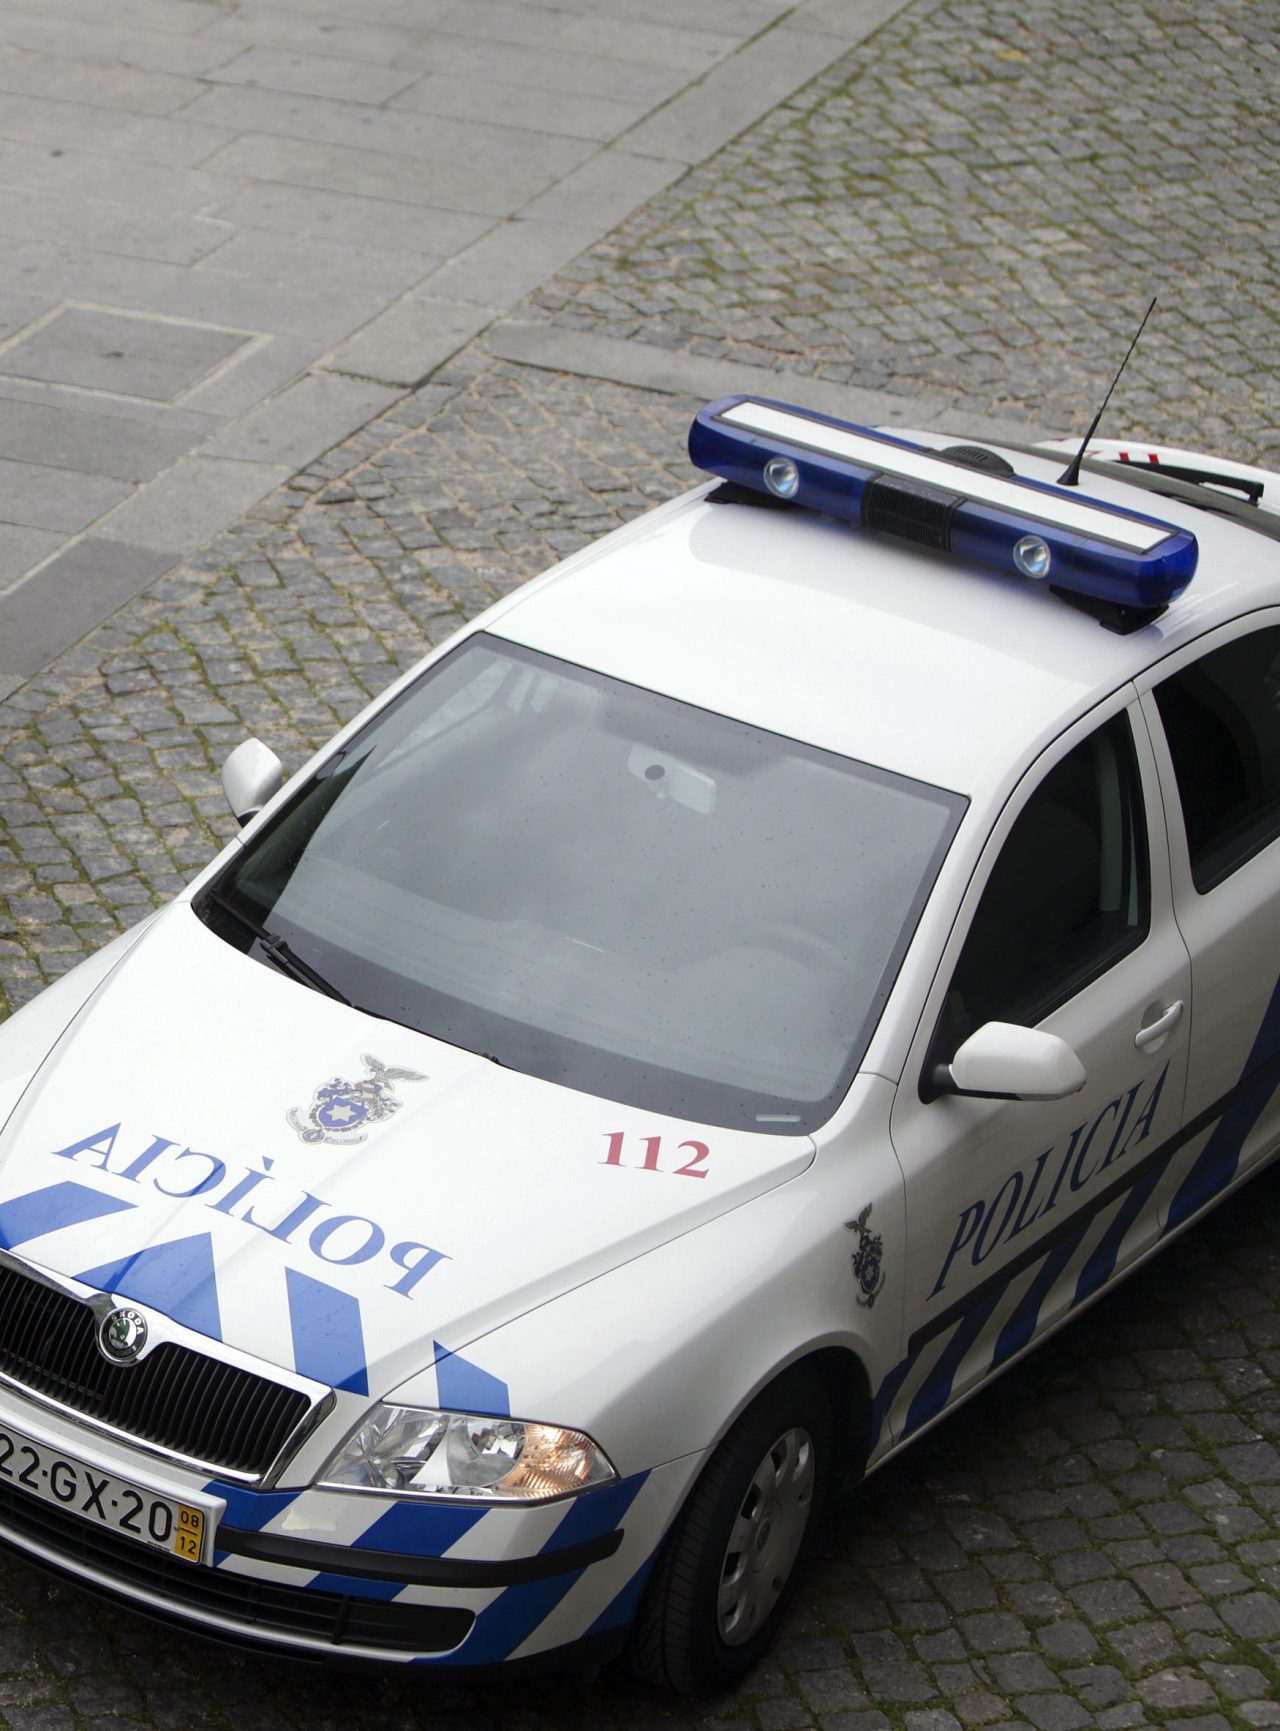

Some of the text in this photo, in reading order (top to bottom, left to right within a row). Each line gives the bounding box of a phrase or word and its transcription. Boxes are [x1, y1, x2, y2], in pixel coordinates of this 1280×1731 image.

[596, 1129, 712, 1180] 112
[925, 1058, 1170, 1302] POLICIA
[179, 1509, 200, 1529] 08
[179, 1536, 197, 1556] 12
